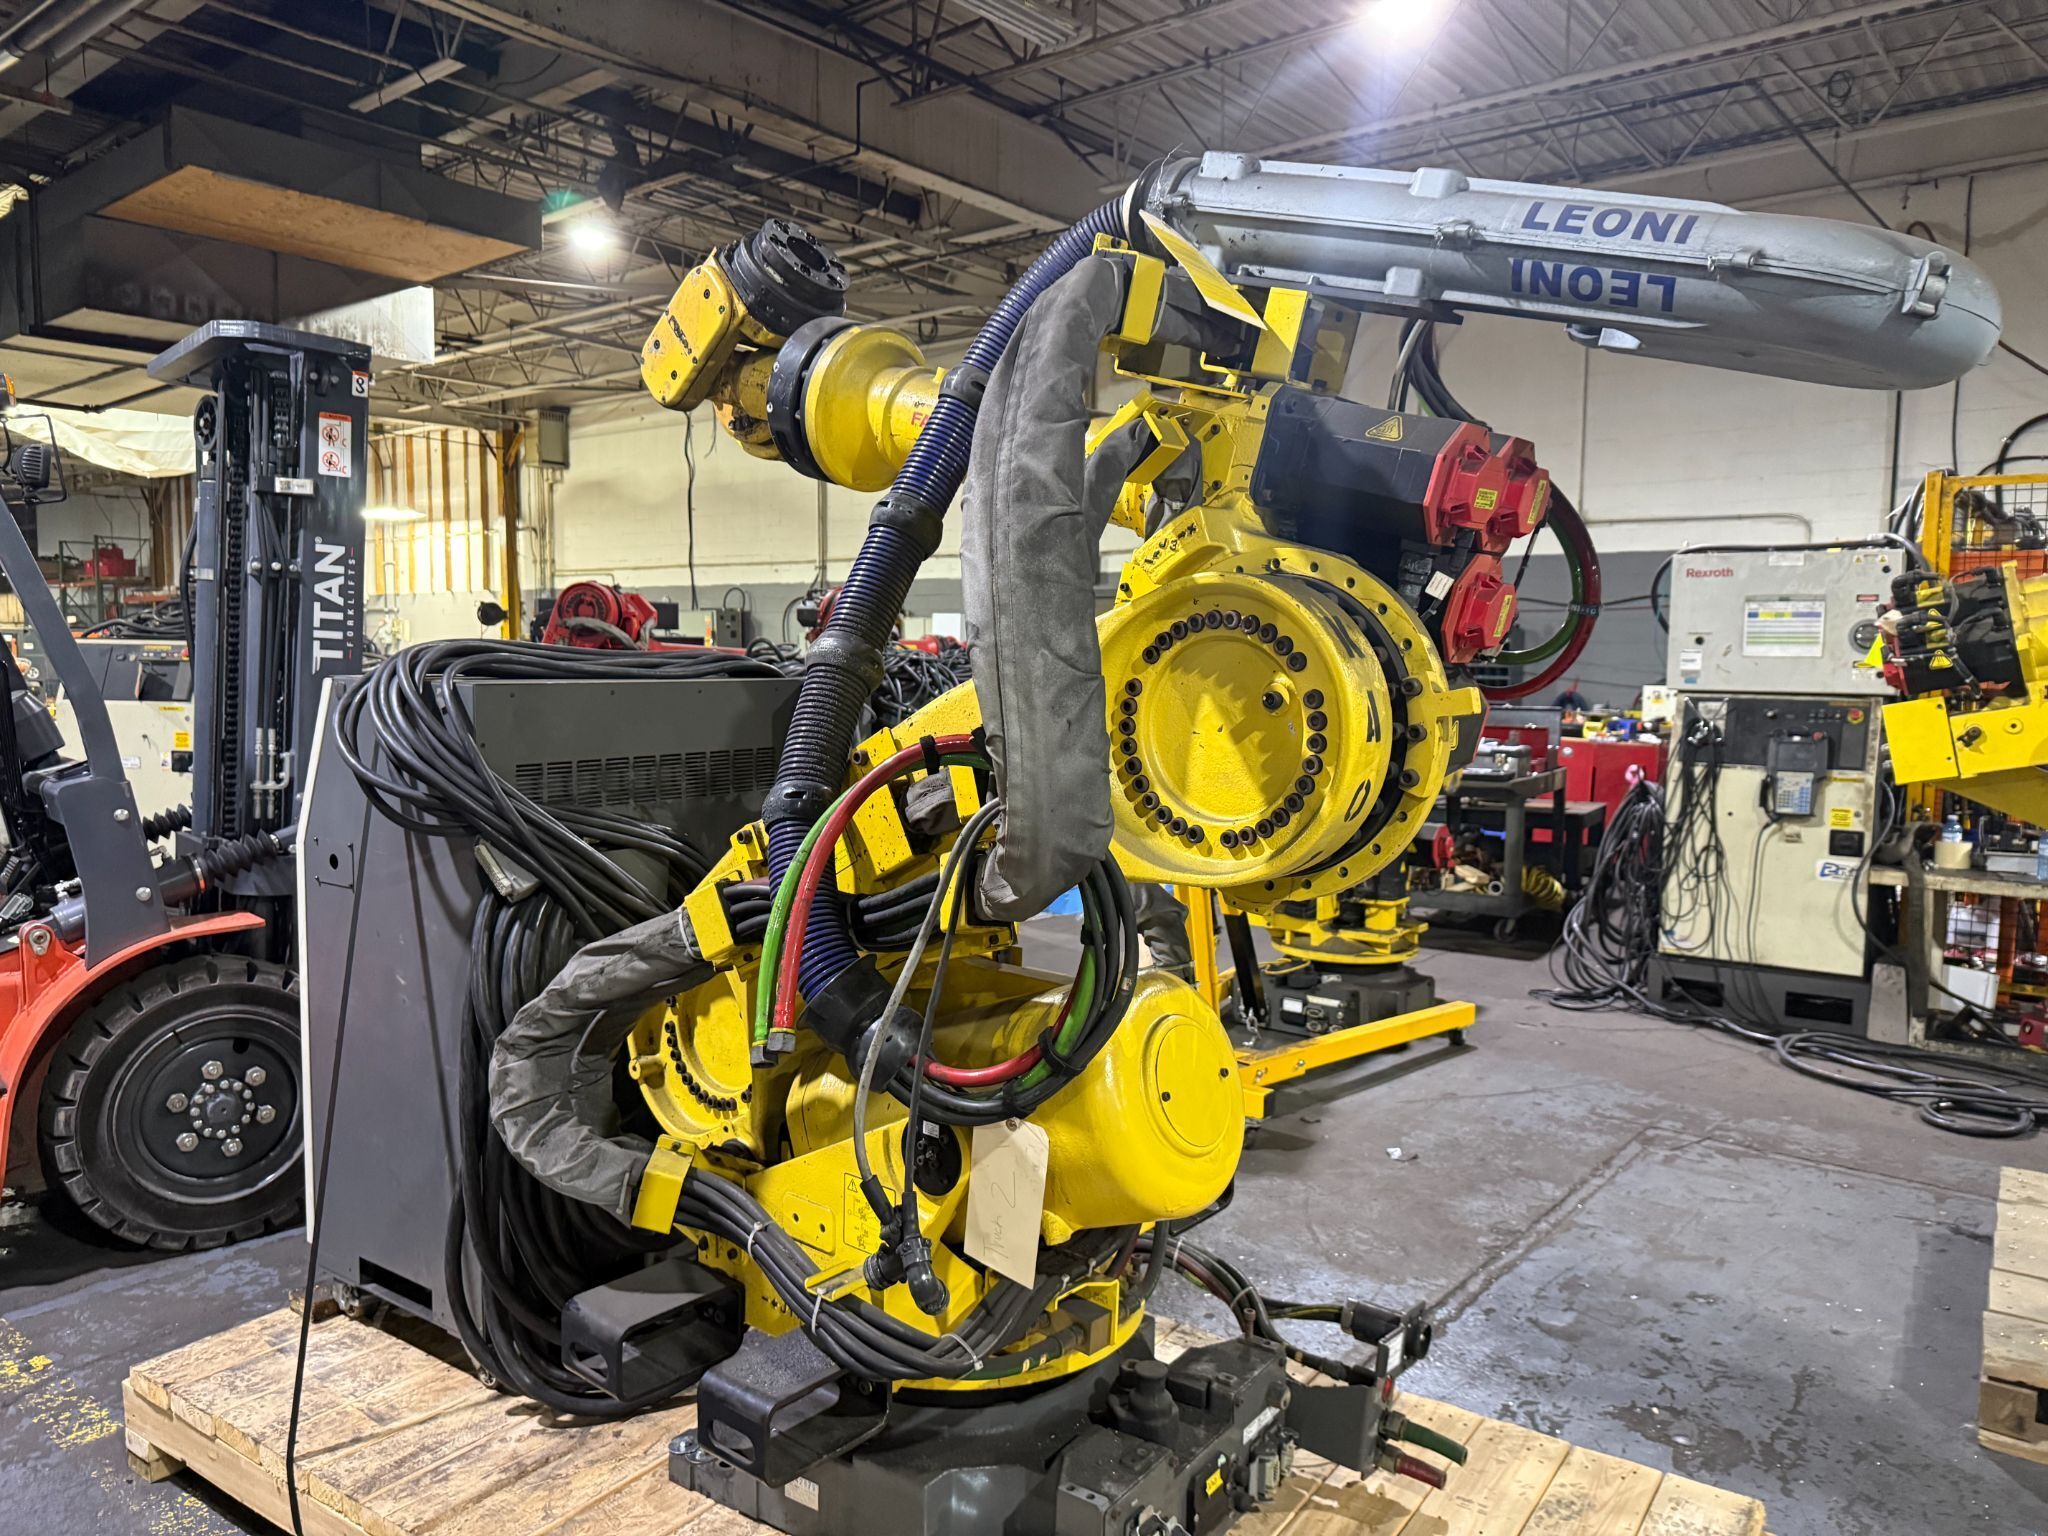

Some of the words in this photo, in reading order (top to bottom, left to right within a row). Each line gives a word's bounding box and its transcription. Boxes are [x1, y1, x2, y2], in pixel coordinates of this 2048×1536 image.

[1520, 201, 1700, 245] LEONI
[1511, 257, 1677, 313] LEONI
[1686, 567, 1734, 578] Rexroth
[312, 543, 346, 675] TITAN
[346, 558, 356, 648] FORKLIFTS
[991, 1171, 1017, 1209] 2
